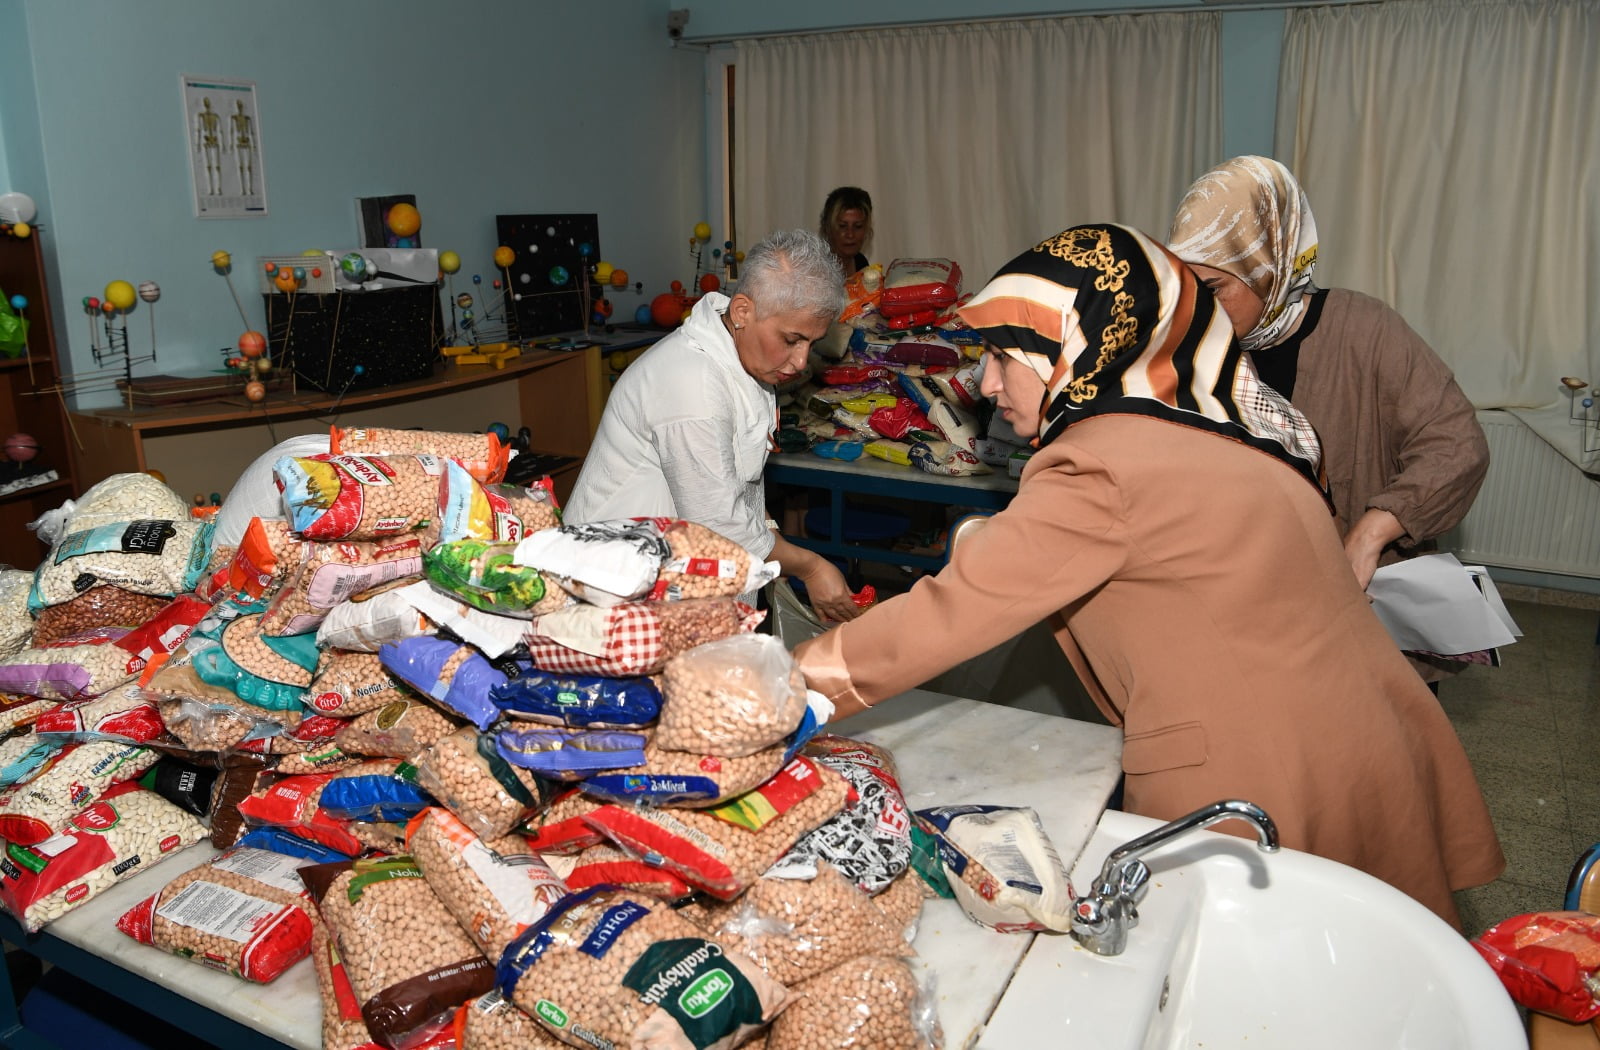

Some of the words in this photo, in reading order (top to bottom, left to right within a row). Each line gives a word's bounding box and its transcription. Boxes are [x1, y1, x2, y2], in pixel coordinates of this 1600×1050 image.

[592, 906, 638, 950] NOHUT
[686, 976, 728, 1009] Torku
[540, 1003, 564, 1024] Torku
